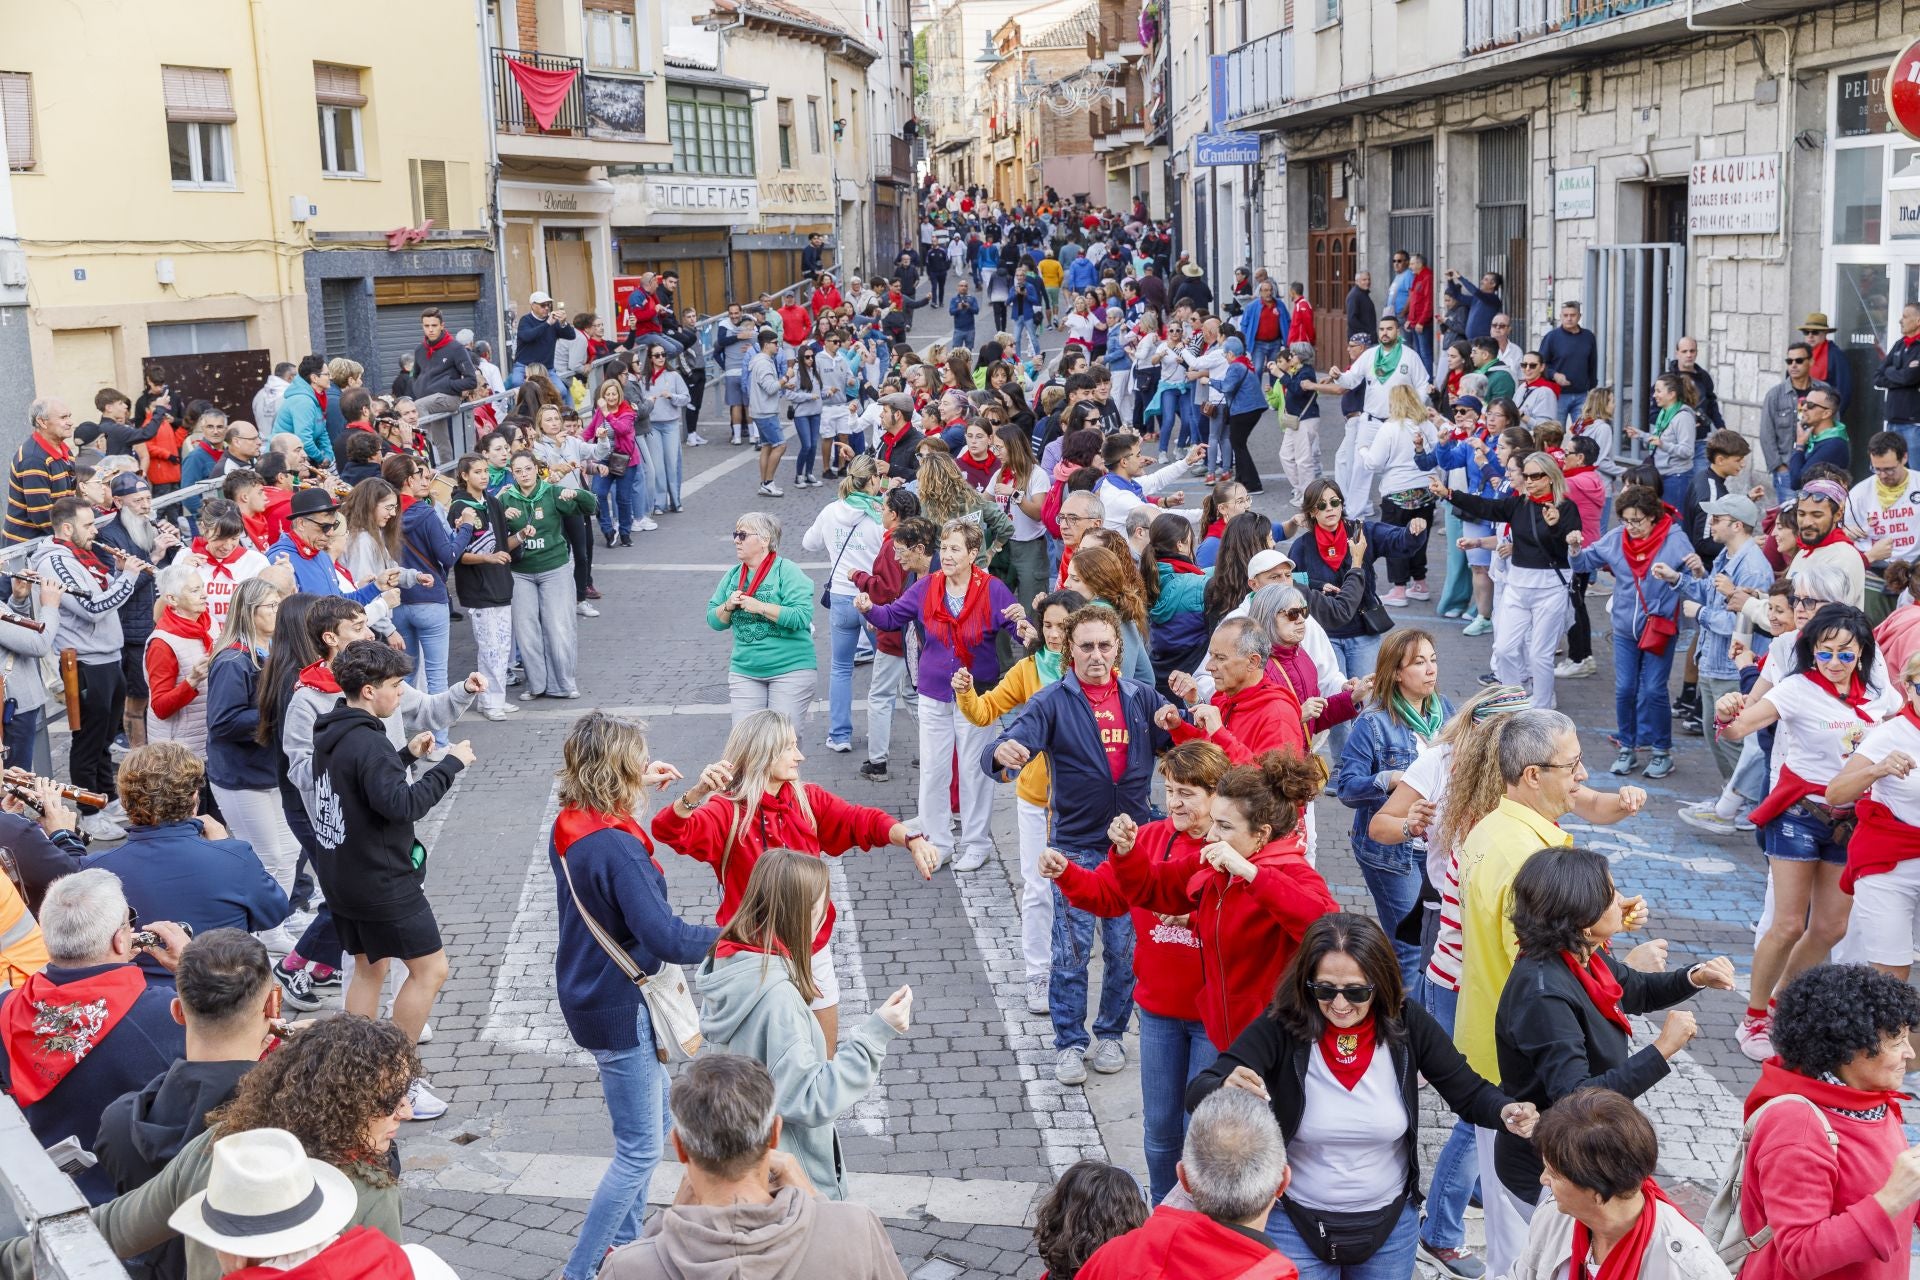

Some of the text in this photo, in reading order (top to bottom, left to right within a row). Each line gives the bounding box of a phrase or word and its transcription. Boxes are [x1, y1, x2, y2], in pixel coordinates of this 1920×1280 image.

[1692, 159, 1775, 185] SE ALQUILAN
[655, 186, 750, 208] BICICLETAS
[1883, 506, 1914, 520] CULPA
[1889, 522, 1909, 534] DEL
